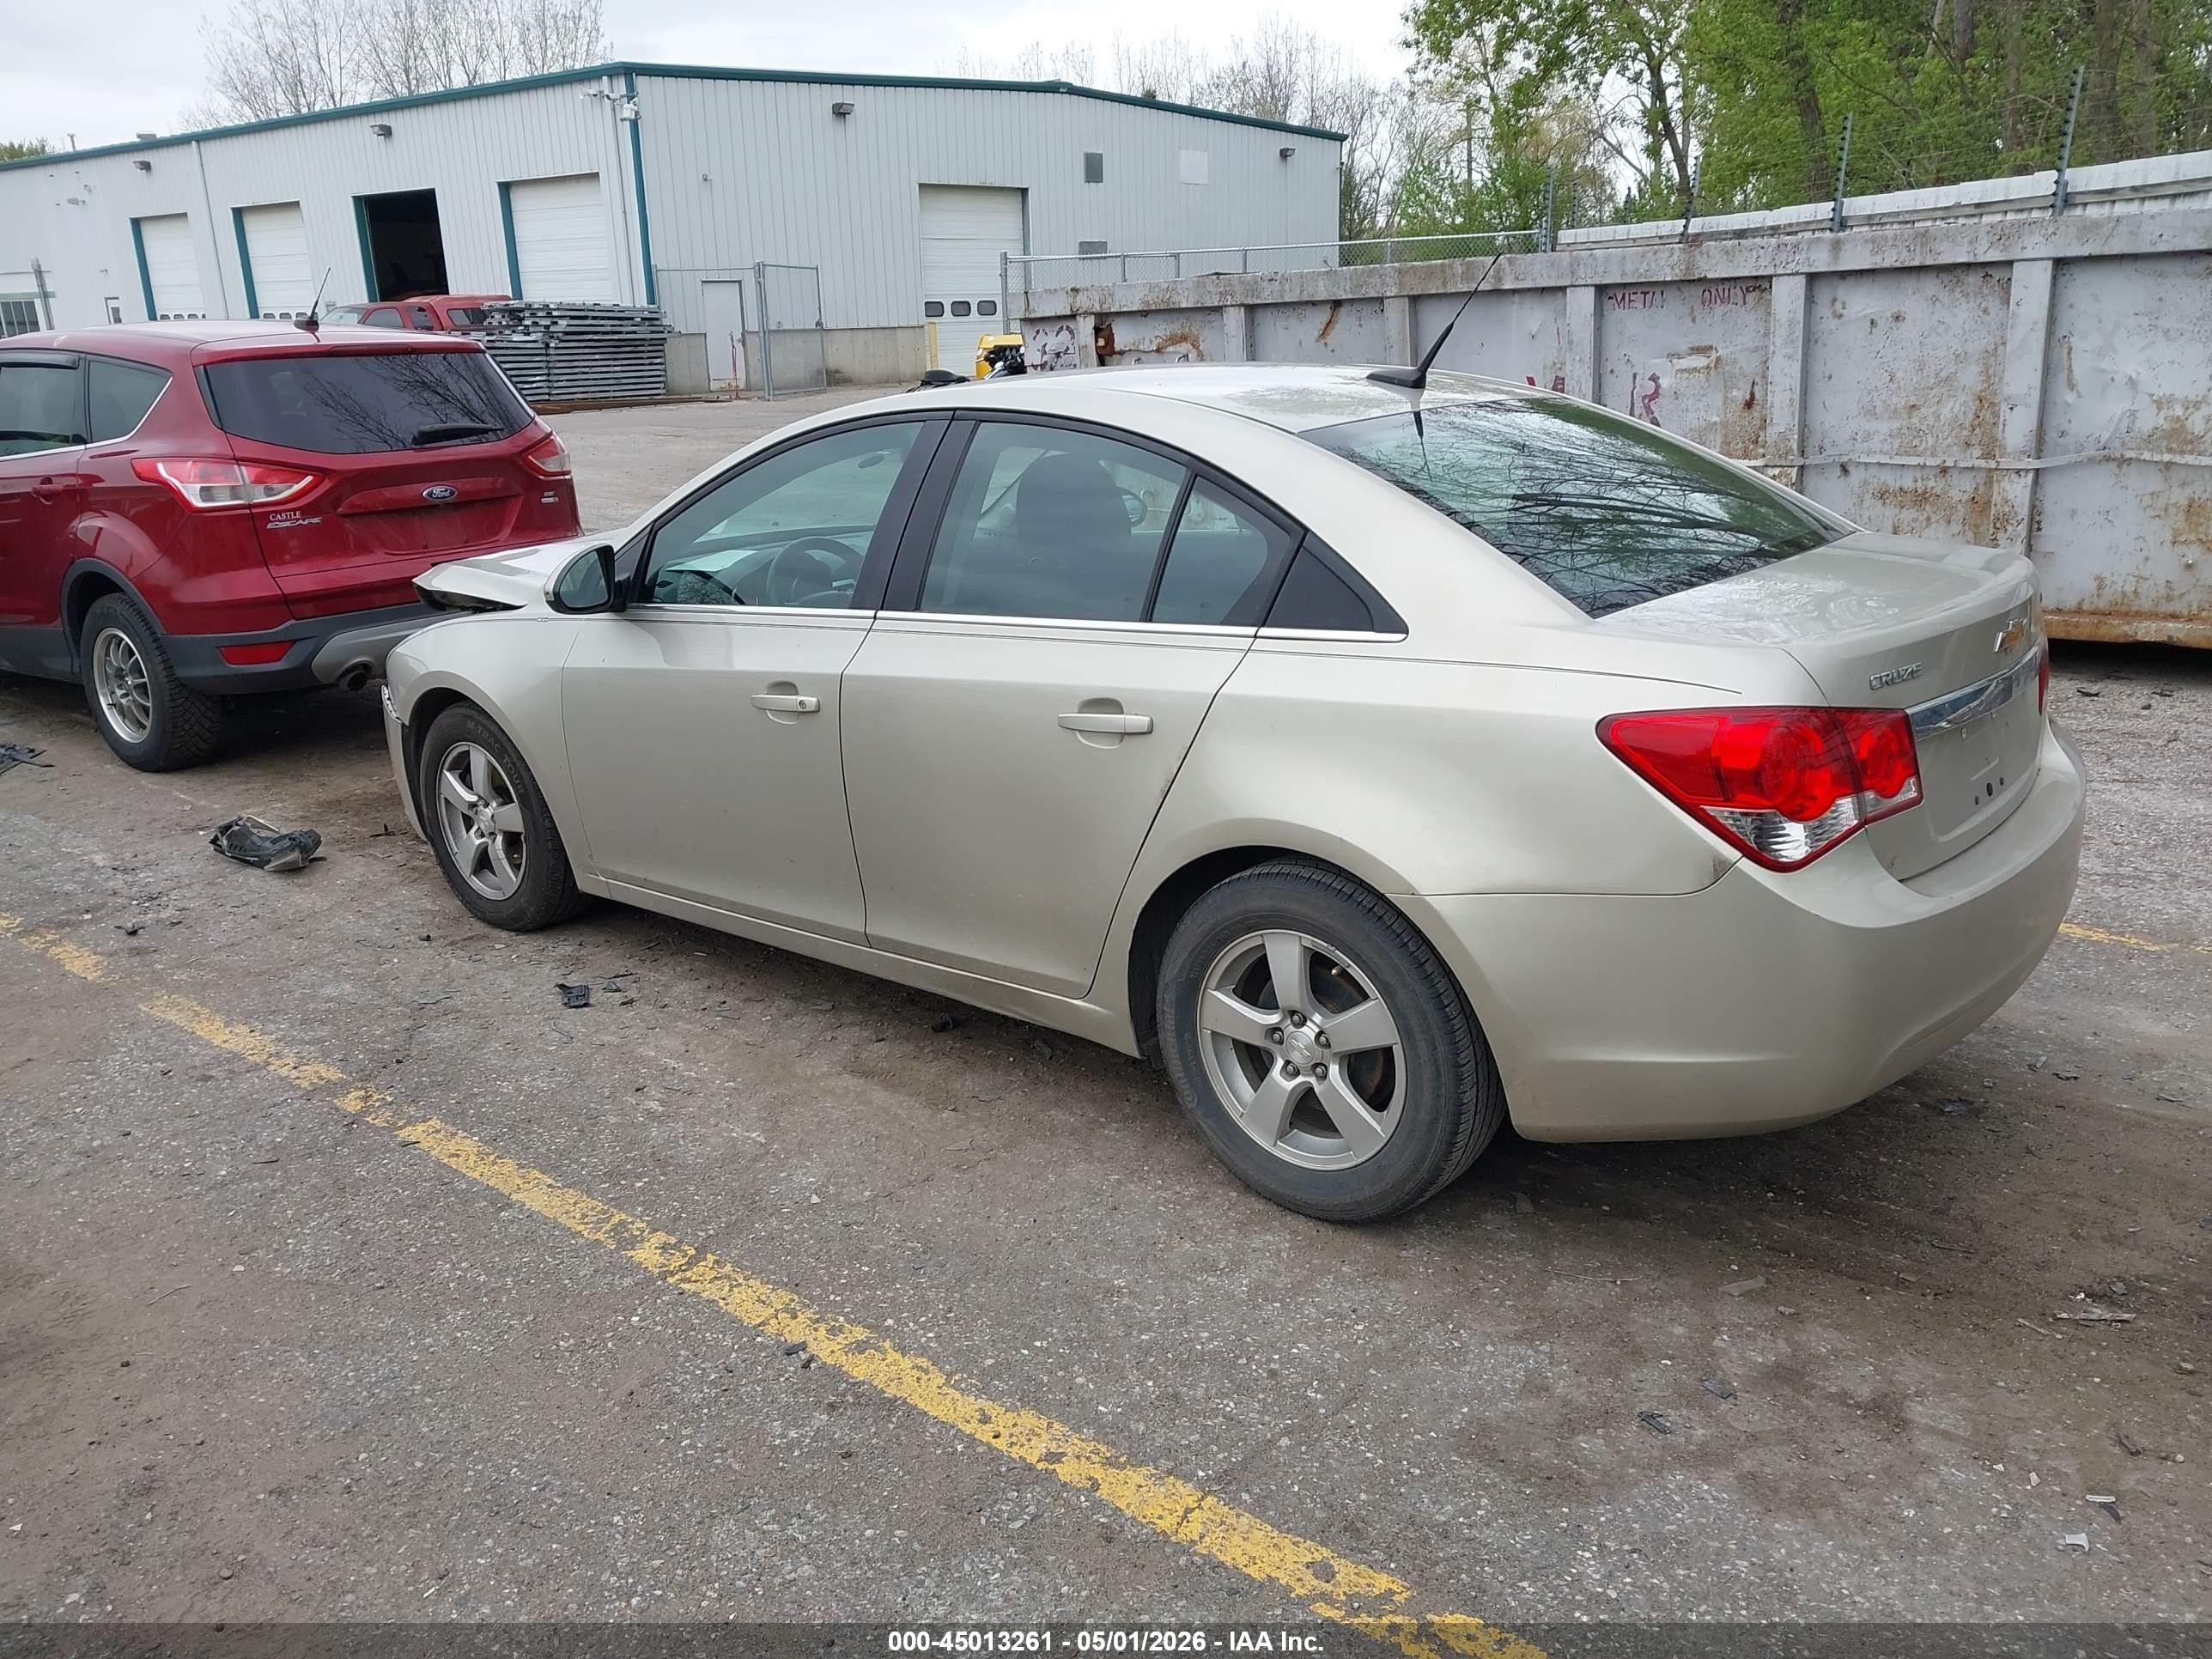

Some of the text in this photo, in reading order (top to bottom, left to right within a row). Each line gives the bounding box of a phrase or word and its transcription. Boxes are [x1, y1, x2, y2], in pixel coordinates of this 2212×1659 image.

[1701, 286, 1747, 308] ONLY
[431, 487, 452, 499] Ford
[270, 510, 301, 521] CASTLE
[1869, 661, 1923, 690] CRUZE
